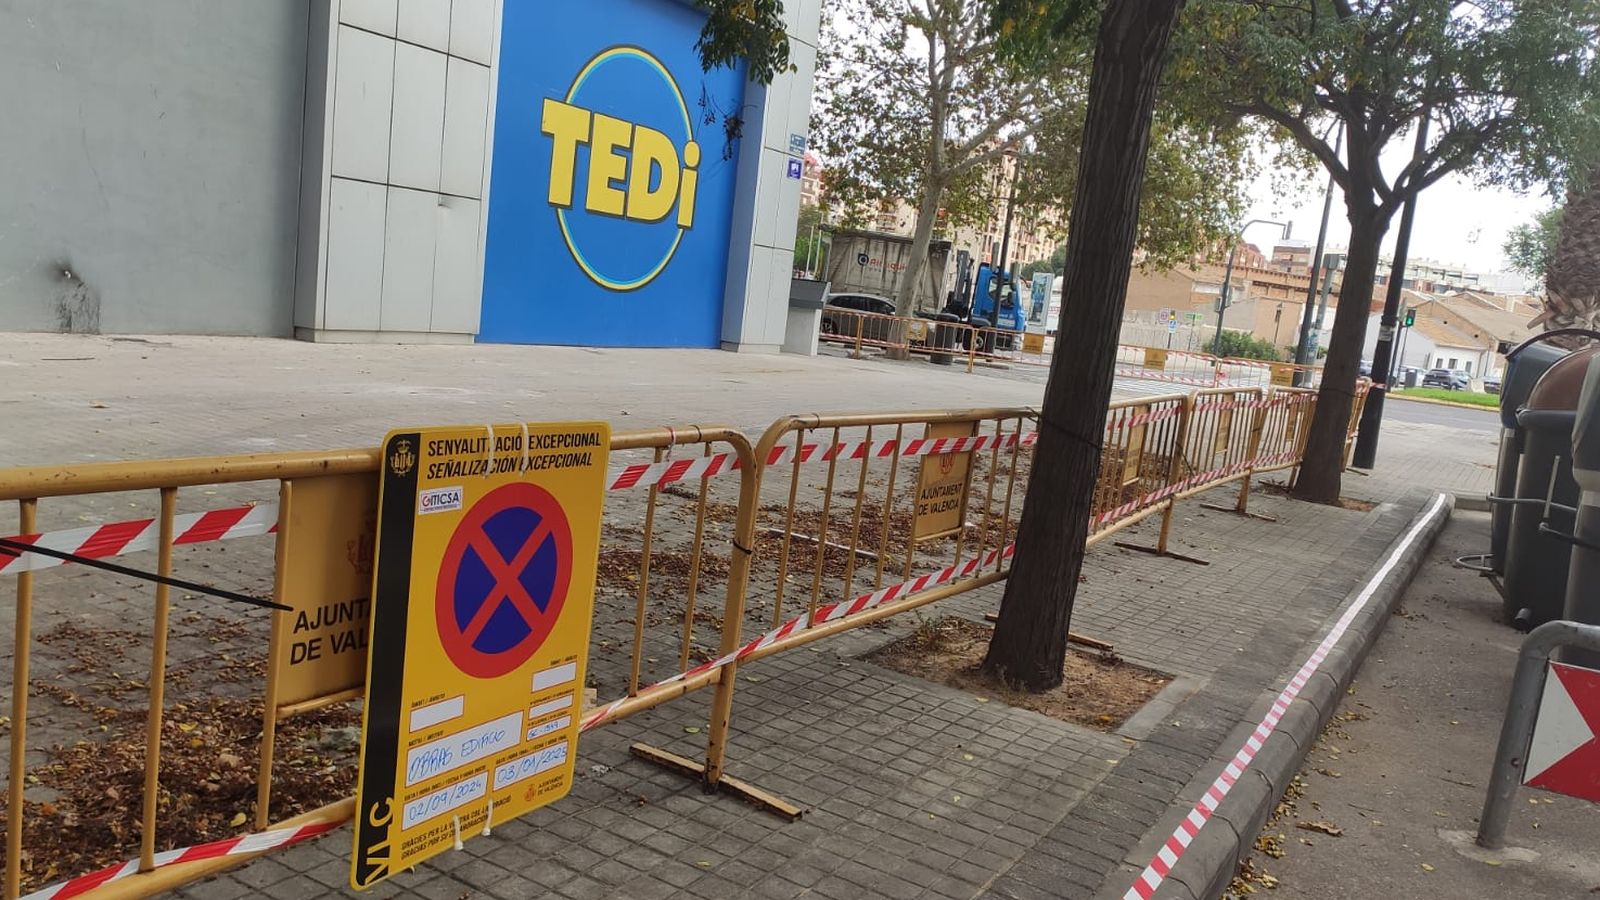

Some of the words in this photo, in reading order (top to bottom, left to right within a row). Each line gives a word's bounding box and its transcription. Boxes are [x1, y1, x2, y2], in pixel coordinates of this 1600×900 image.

[541, 97, 701, 229] TEDi
[428, 433, 522, 457] SENYALITACIÓ
[529, 432, 602, 450] EXCEPCIONAL
[921, 482, 962, 500] AJUNTAMENT
[918, 504, 928, 516] DE
[293, 598, 370, 634] AJUNT
[290, 638, 322, 665] DE
